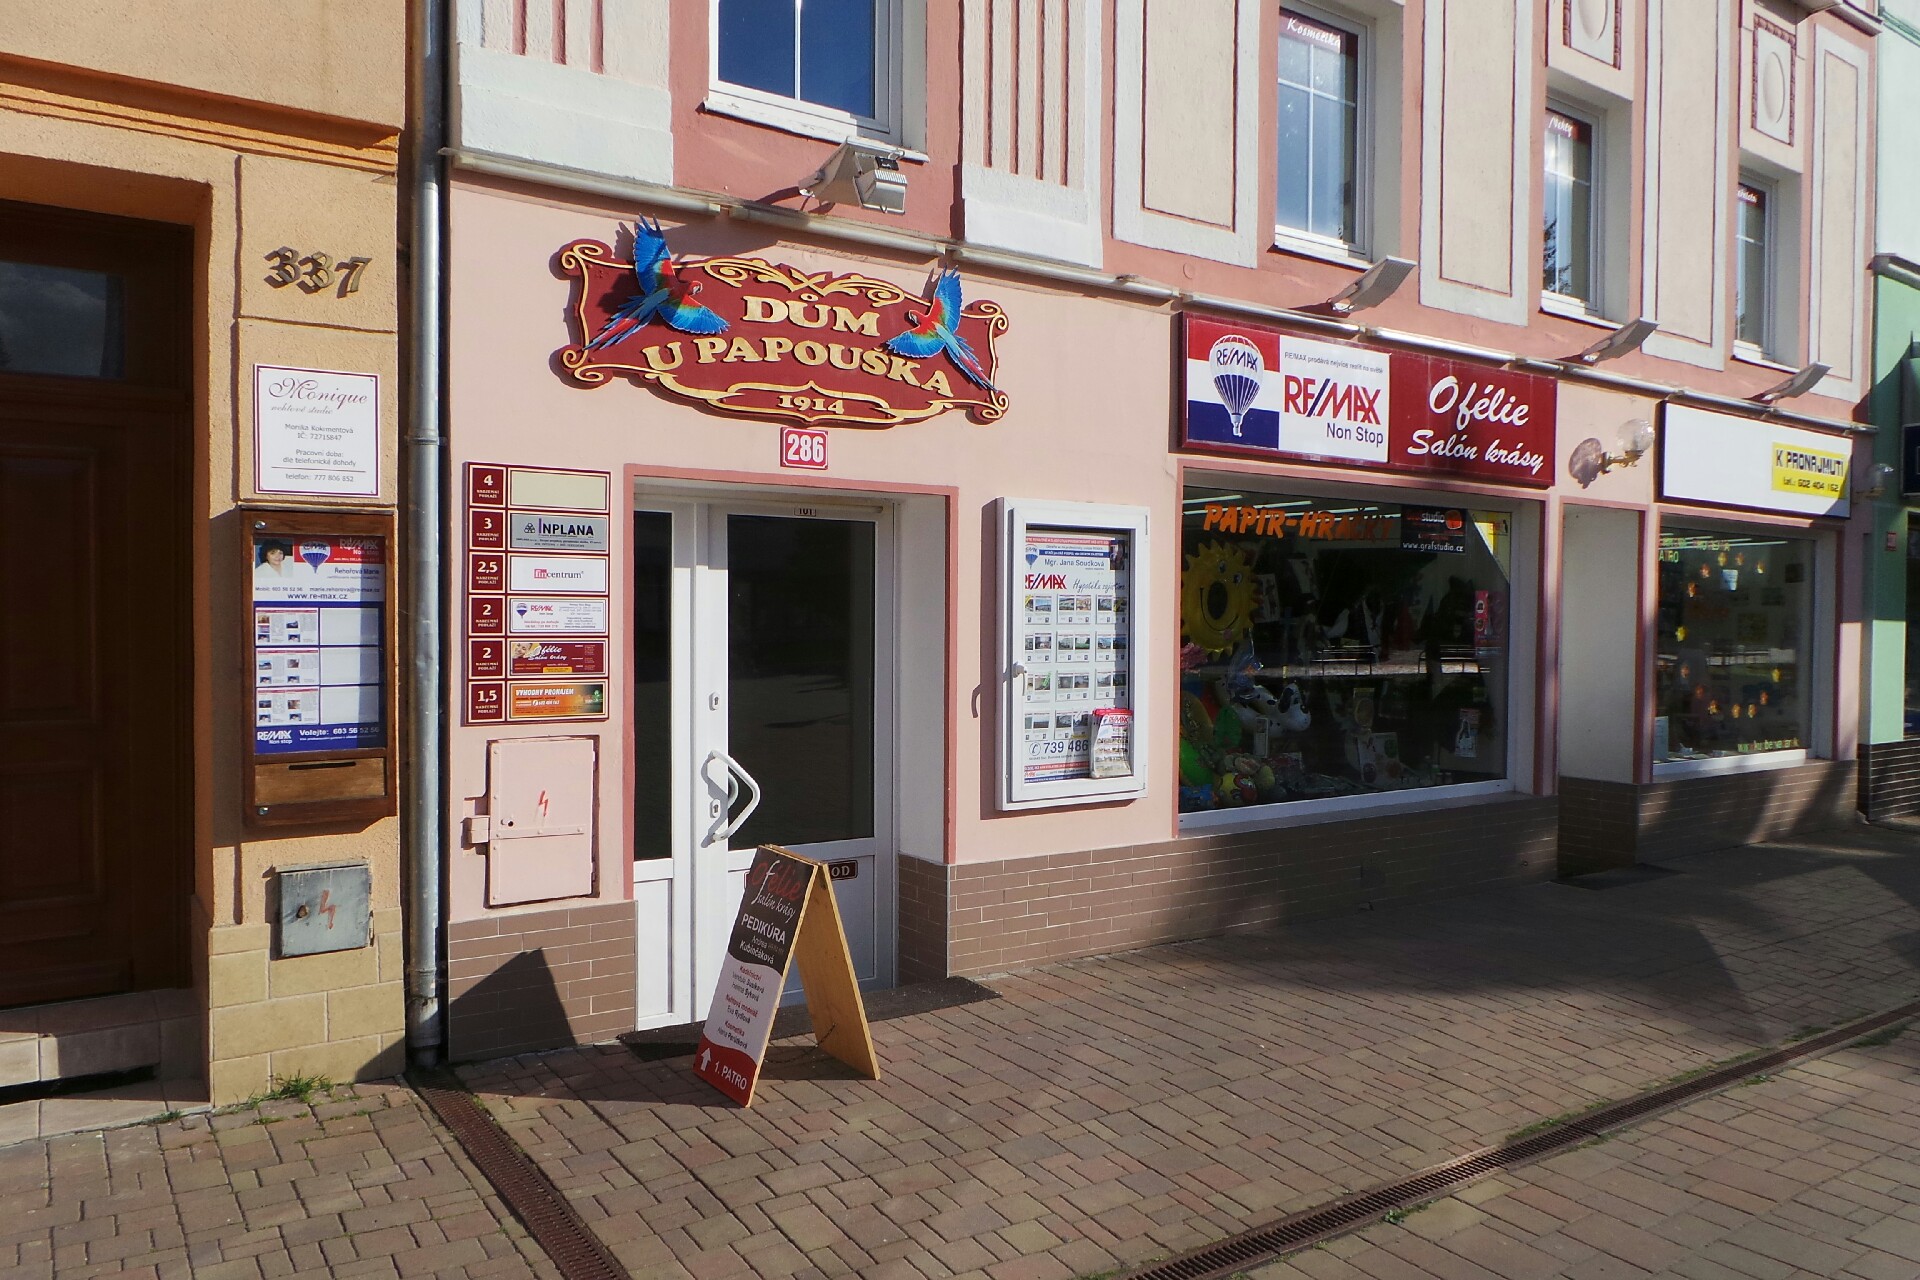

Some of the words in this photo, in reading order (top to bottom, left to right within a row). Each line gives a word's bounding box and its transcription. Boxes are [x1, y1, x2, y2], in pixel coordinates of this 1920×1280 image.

[1286, 17, 1341, 48] Kosmetika
[272, 246, 373, 297] 337
[743, 293, 880, 337] DŮM
[646, 342, 684, 371] U
[693, 336, 954, 397] PAPOUŠKA
[1216, 347, 1258, 371] RE/MAX
[269, 378, 368, 410] Monique
[1284, 374, 1382, 425] RE/MAX
[778, 395, 845, 414] 1914
[1429, 376, 1529, 431] Ofélie
[1326, 422, 1352, 440] Non
[1356, 425, 1384, 448] Stop
[296, 449, 324, 457] Pracovní
[787, 434, 824, 462] 286
[1407, 429, 1479, 460] Salón
[1485, 440, 1544, 475] krásy
[333, 459, 356, 467] dohody
[1776, 449, 1783, 467] K
[483, 474, 494, 486] 4
[483, 517, 493, 529] 3
[1402, 541, 1464, 552] www.grafstudio.cz
[477, 561, 498, 574] 2,5
[1044, 559, 1059, 567] Mgr.
[482, 604, 492, 616] 2
[482, 647, 492, 659] 2
[477, 690, 498, 702] 1,5
[257, 730, 292, 740] RE/MAX
[299, 729, 330, 737] Volejte:
[1044, 742, 1065, 754] 739
[1068, 740, 1089, 752] 486
[741, 913, 786, 945] PEDIKÚRA
[721, 1066, 748, 1091] PATRO
